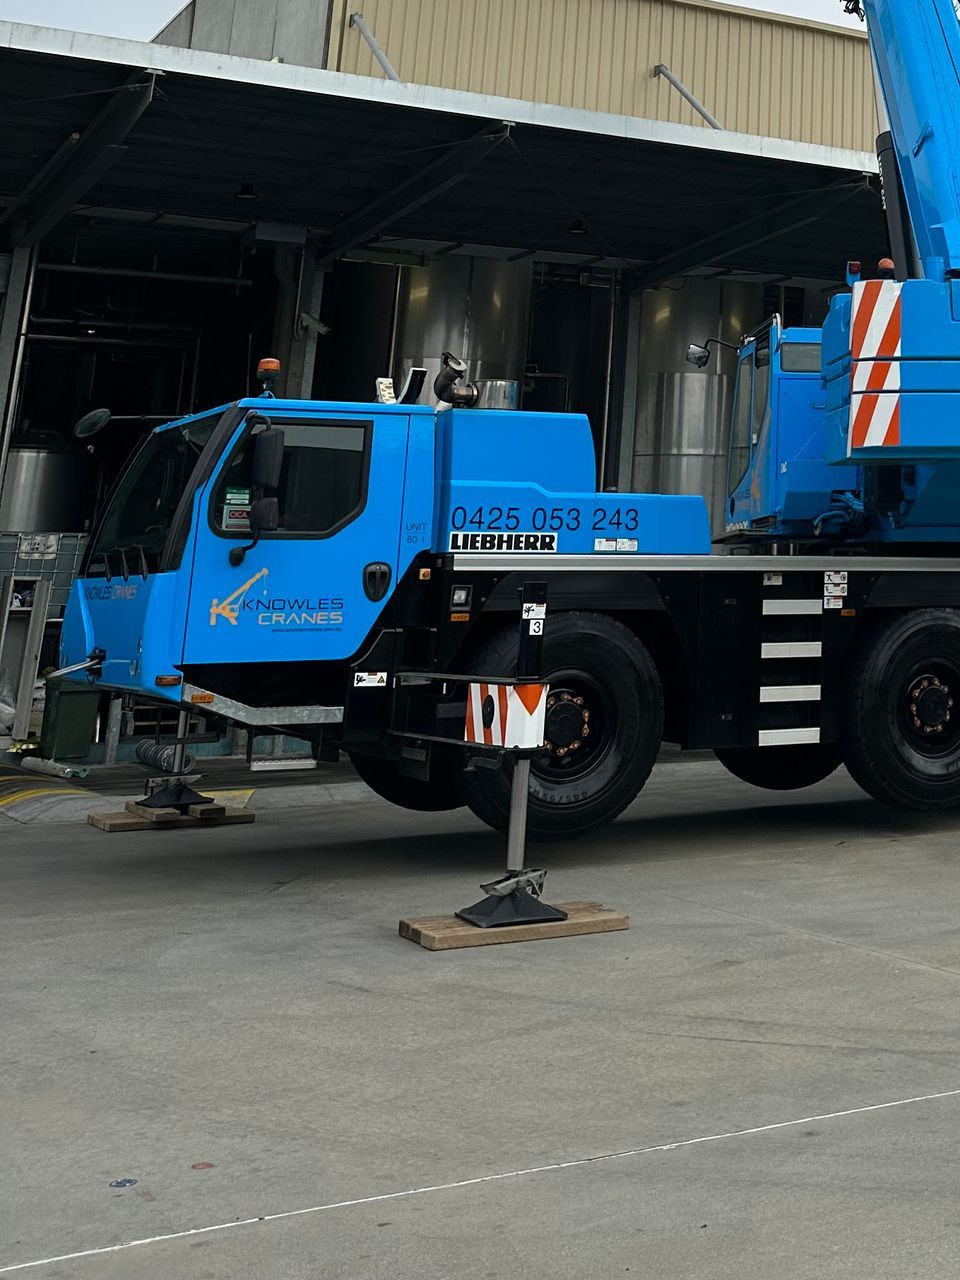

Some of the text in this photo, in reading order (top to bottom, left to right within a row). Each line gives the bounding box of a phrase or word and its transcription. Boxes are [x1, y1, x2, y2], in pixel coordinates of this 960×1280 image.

[451, 506, 639, 531] 0425 053 243
[406, 522, 426, 531] UNIT
[451, 533, 555, 551] LIEBHERR
[242, 598, 344, 611] KNOWLES
[258, 612, 343, 625] CRANES
[533, 621, 541, 634] 3
